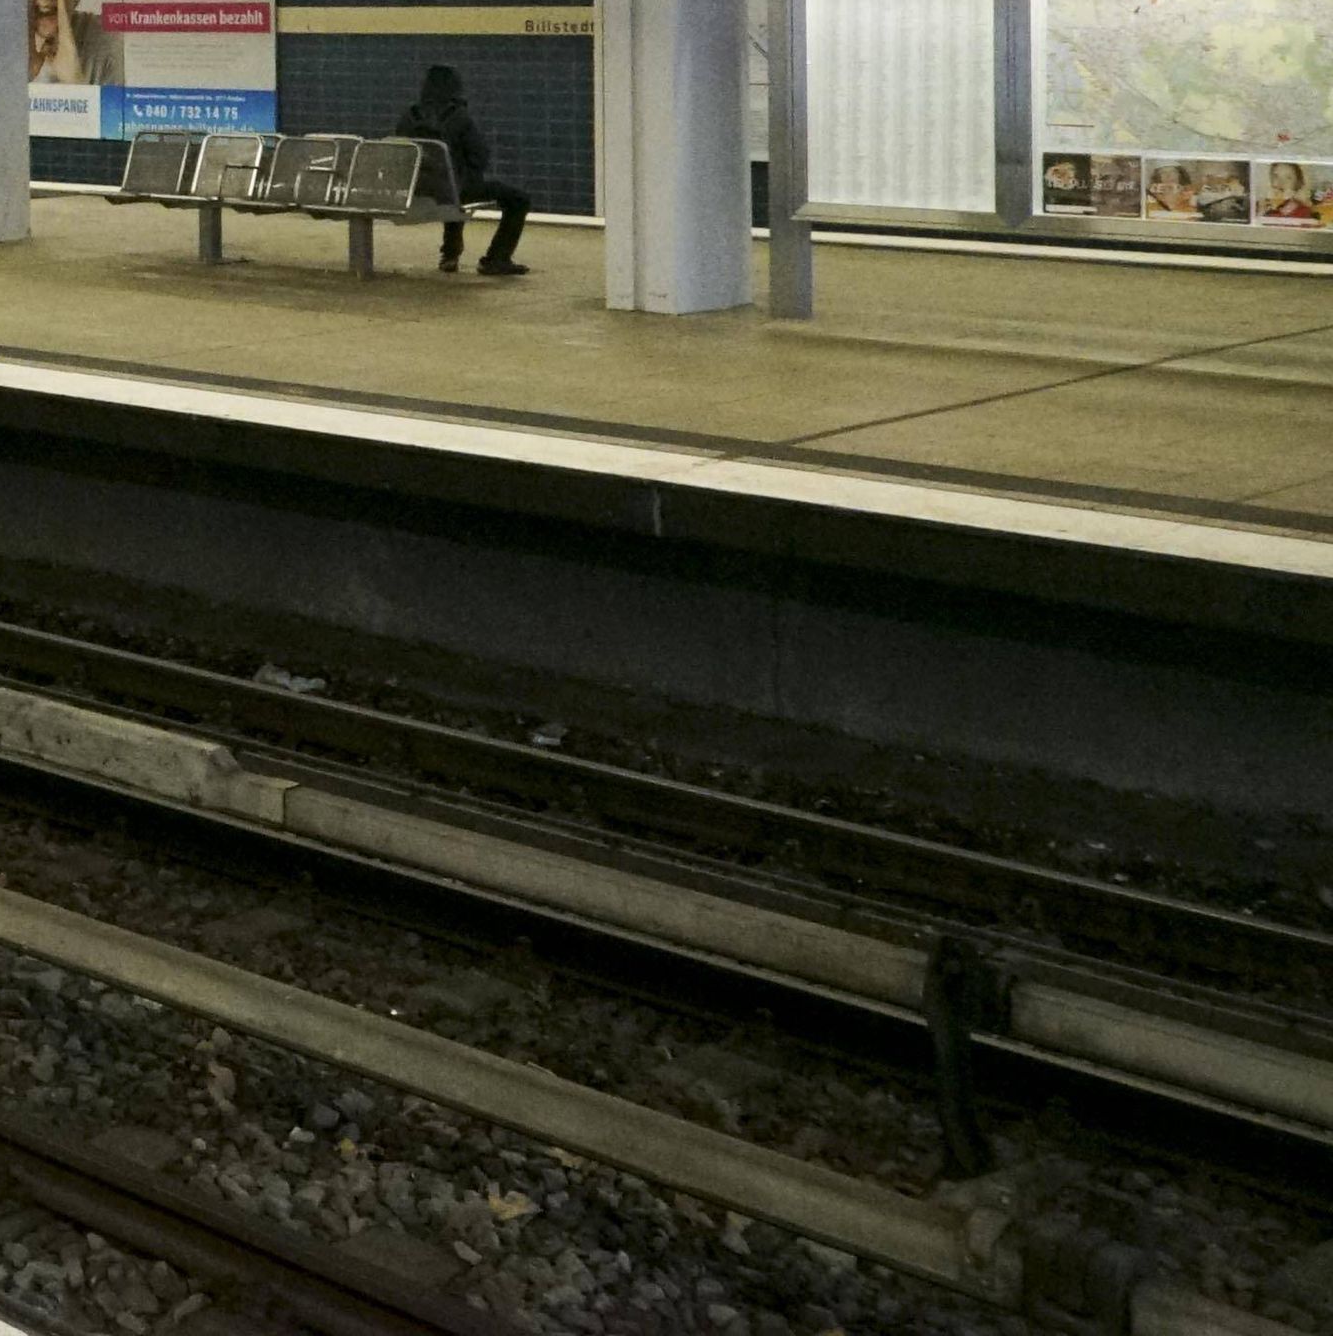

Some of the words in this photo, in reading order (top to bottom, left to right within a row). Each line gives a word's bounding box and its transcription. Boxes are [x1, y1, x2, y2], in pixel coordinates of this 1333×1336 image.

[130, 11, 217, 26] Krankenkassen
[219, 10, 264, 26] bezahlt
[524, 19, 595, 33] Billstedt
